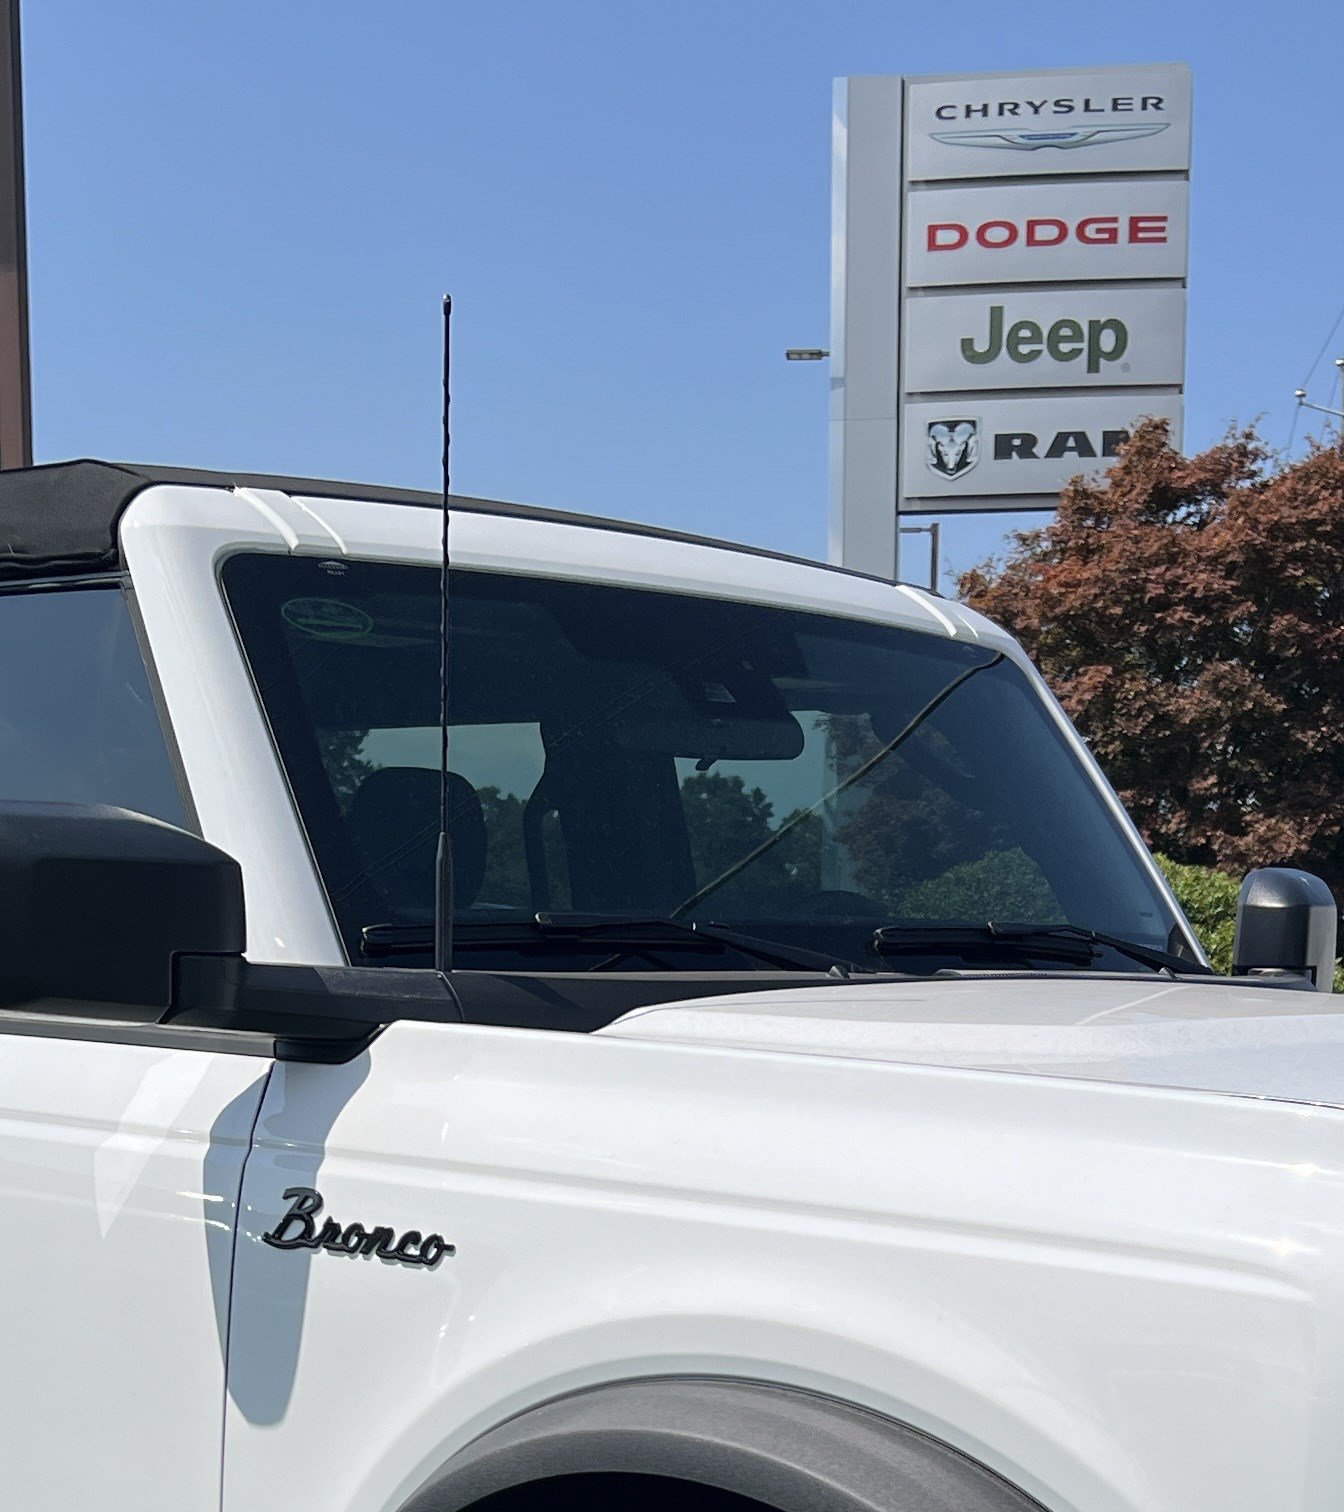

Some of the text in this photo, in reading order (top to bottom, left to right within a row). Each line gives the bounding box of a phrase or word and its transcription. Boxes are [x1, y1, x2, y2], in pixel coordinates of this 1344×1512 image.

[935, 96, 1165, 121] CHRYSLER
[926, 215, 1169, 252] DODGE
[960, 305, 1130, 374] Jeep
[261, 1187, 456, 1268] Bronco
